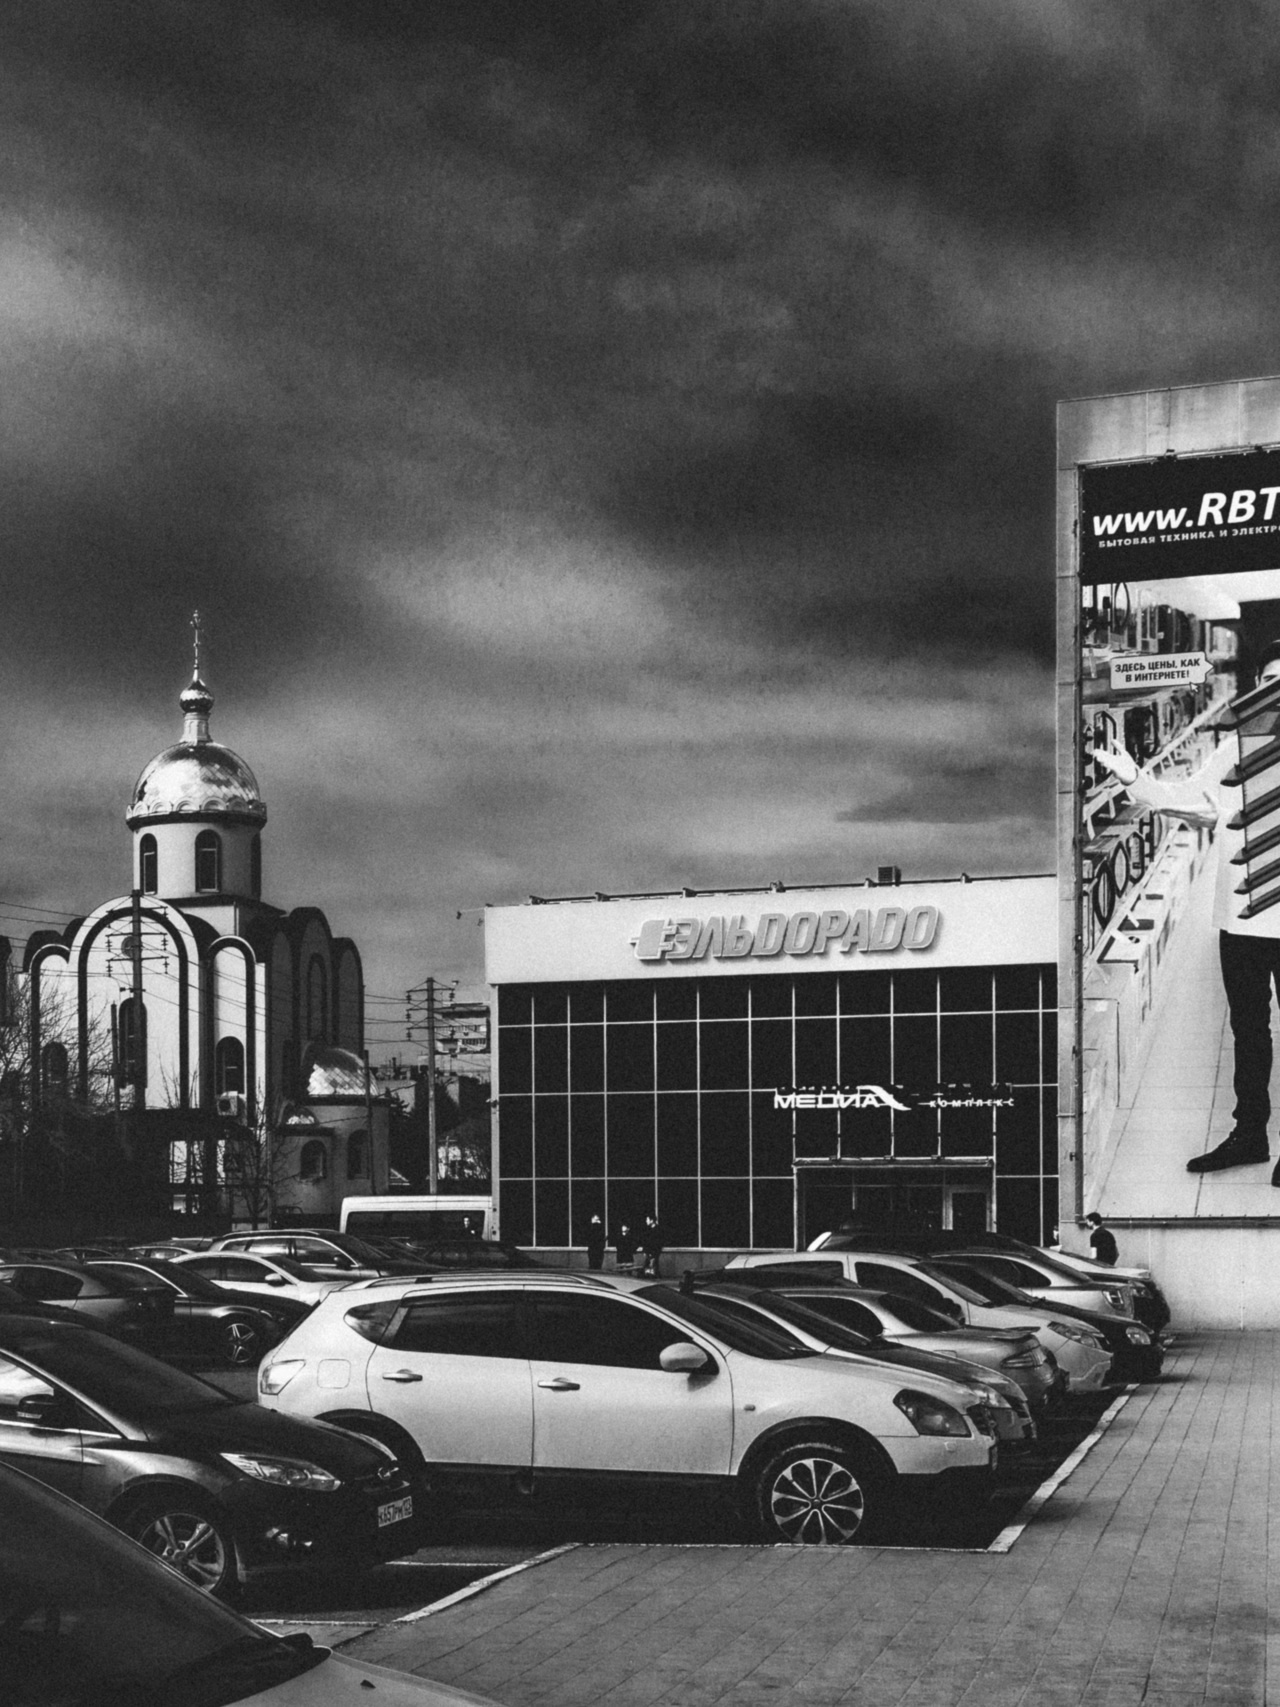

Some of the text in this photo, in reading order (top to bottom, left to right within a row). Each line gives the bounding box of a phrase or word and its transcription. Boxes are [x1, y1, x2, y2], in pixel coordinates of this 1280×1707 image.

[1098, 525, 1280, 548] БЫТОВАЯ ТЕХНИКА И ЭЛЕКТР
[1114, 658, 1200, 673] ЗДЕСЬ ЦЕНЫ, КАК
[1125, 670, 1190, 682] В ИНТЕРНЕТЕ!
[929, 1097, 1014, 1108] КОМПЛЕКС
